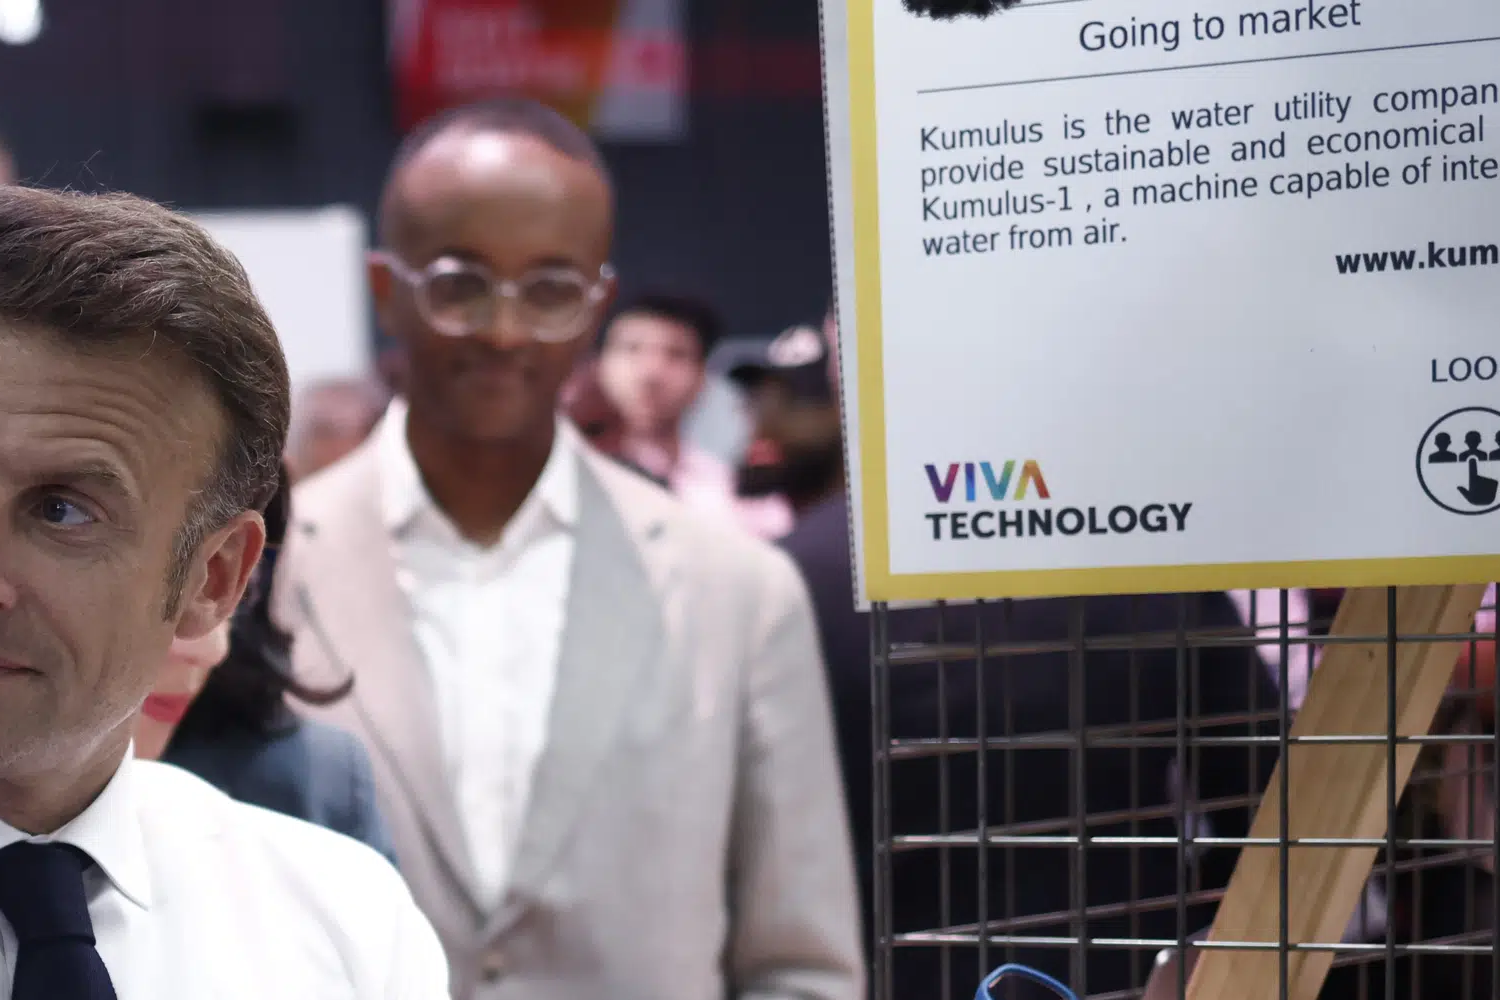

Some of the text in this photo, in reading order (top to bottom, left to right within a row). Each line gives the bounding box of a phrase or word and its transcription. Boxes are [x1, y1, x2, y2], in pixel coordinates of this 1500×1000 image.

[1078, 0, 1362, 53] Going to market
[920, 82, 1499, 153] Kumulus is the water utility compan
[920, 114, 1485, 194] provide sustainable and economical
[922, 186, 1073, 222] Kumulus-1
[1103, 187, 1120, 209] a
[1132, 173, 1258, 207] machine
[1269, 160, 1391, 201] capable
[1401, 155, 1433, 187] of
[1442, 154, 1499, 184] inte
[922, 214, 1128, 257] water from air.
[1334, 240, 1500, 275] www.kum
[1431, 355, 1498, 384] LOO
[924, 460, 1051, 504] VIVA
[924, 501, 1193, 542] TECHNOLOGY
